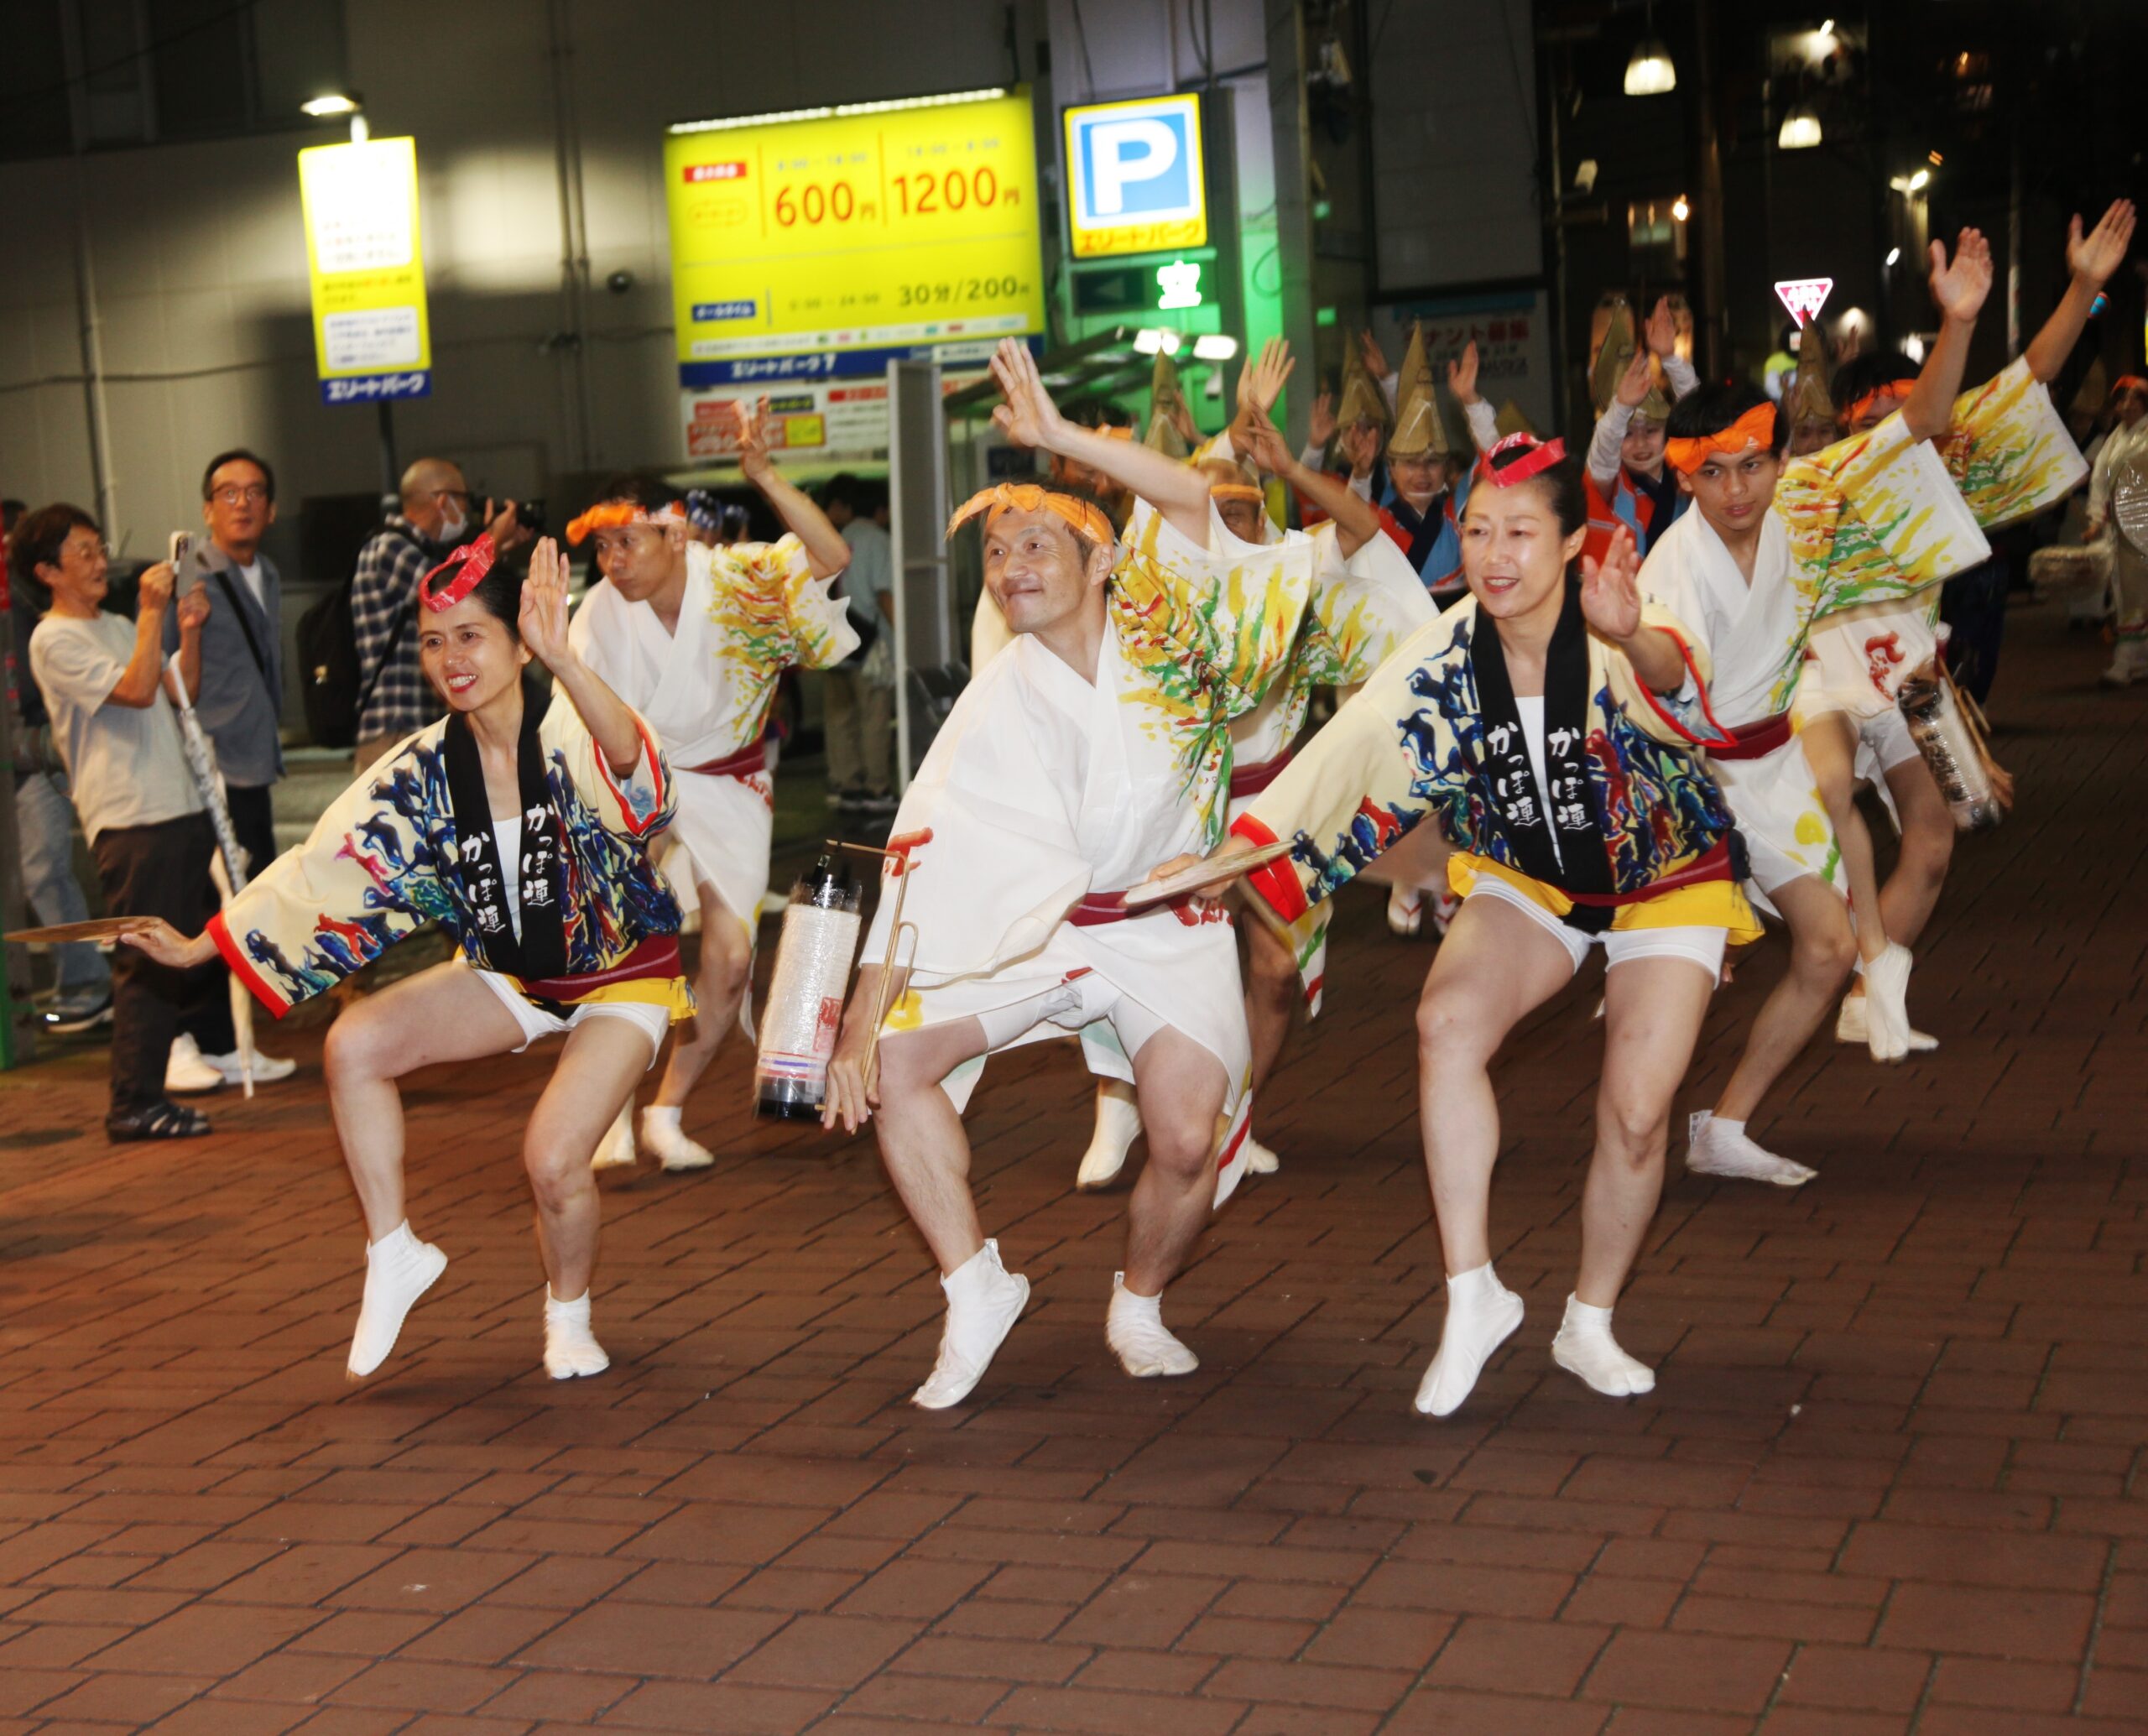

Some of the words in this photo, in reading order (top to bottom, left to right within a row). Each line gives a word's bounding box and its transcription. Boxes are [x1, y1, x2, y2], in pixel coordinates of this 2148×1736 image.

[1091, 118, 1177, 215] P
[1080, 222, 1201, 253] エリートパーク
[327, 373, 425, 400] エリートパーク
[1487, 722, 1541, 826] かっぽ連
[1547, 727, 1593, 830] かっぽ連
[461, 832, 506, 933] かっぽ連
[523, 804, 555, 907] かっぽ連
